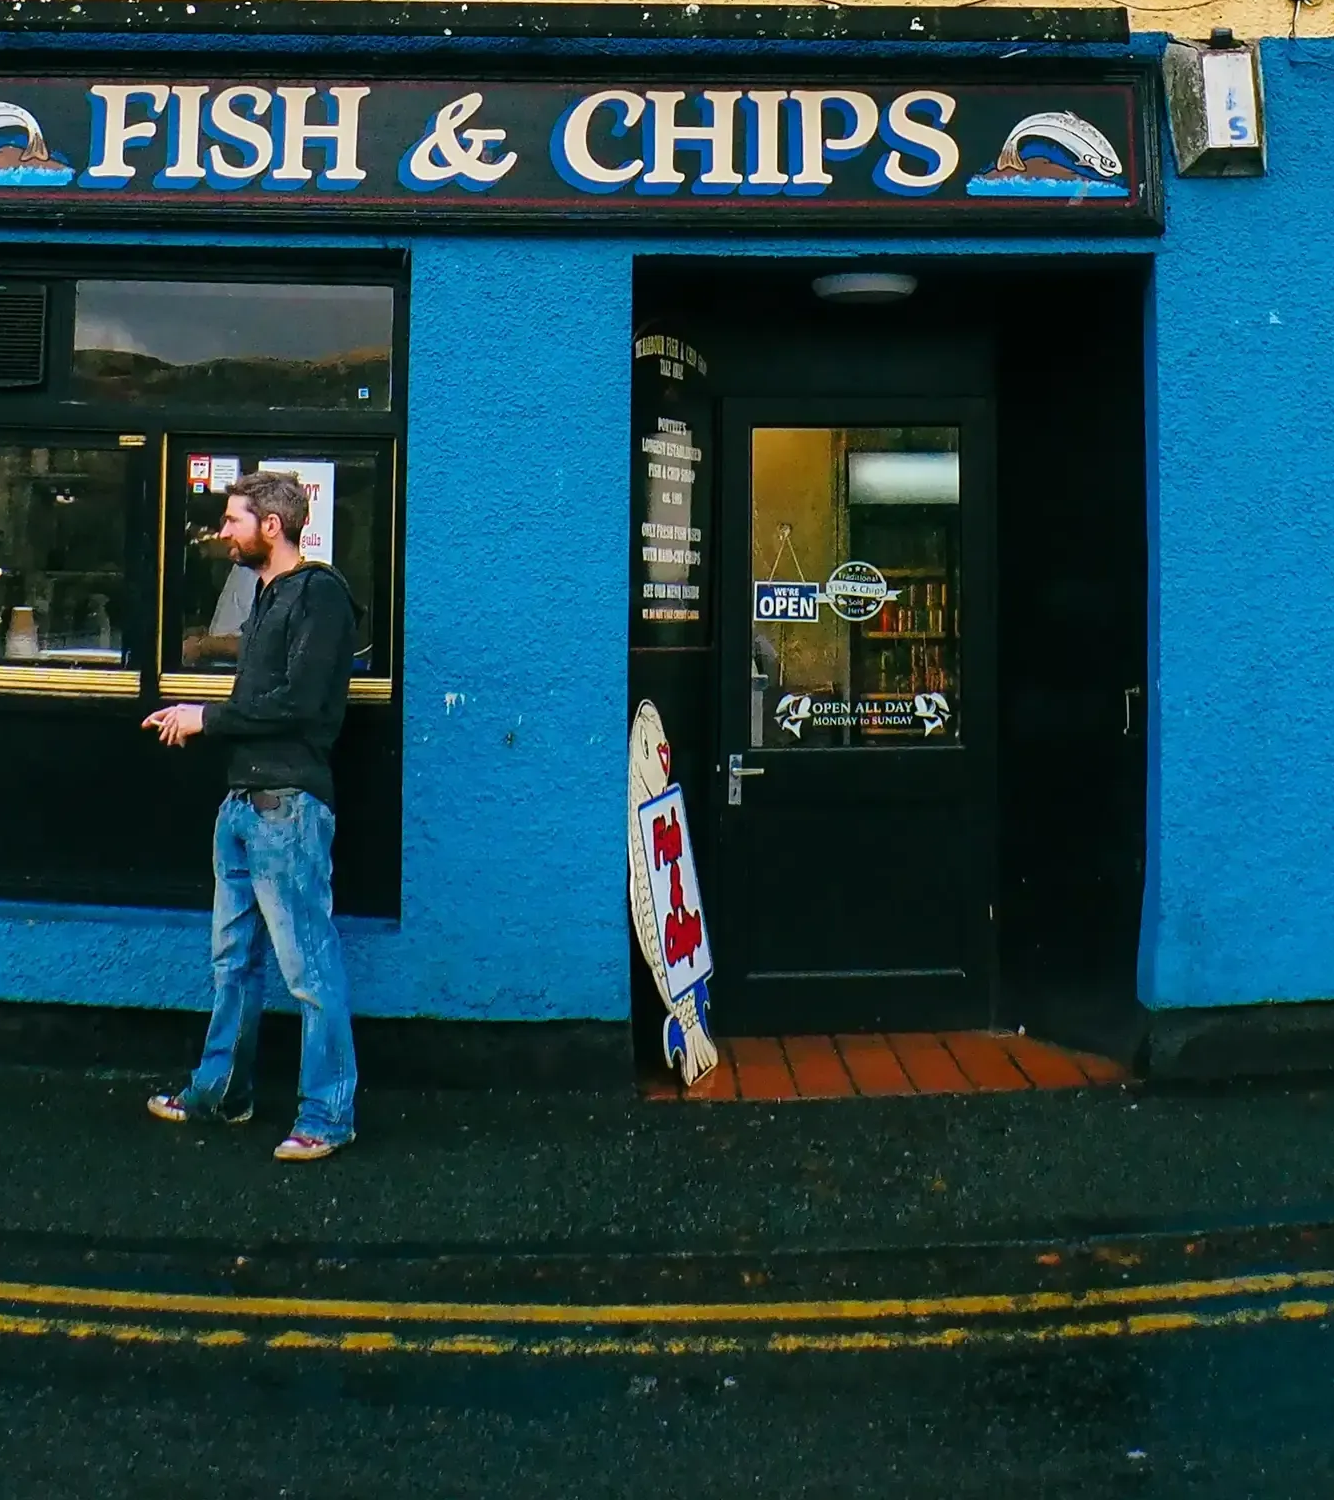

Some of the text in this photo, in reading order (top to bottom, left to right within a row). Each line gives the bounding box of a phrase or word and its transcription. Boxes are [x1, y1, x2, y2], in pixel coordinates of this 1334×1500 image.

[79, 84, 960, 195] FISH & CHIPS
[838, 571, 879, 583] Traditional
[773, 587, 800, 596] WE'RE
[828, 583, 885, 596] Fish & Chips
[759, 596, 814, 618] OPEN
[848, 598, 864, 607] Sold
[847, 606, 865, 615] Here
[812, 701, 914, 714] OPEN ALL DAY
[812, 715, 914, 727] MONDAY to SUNDAY
